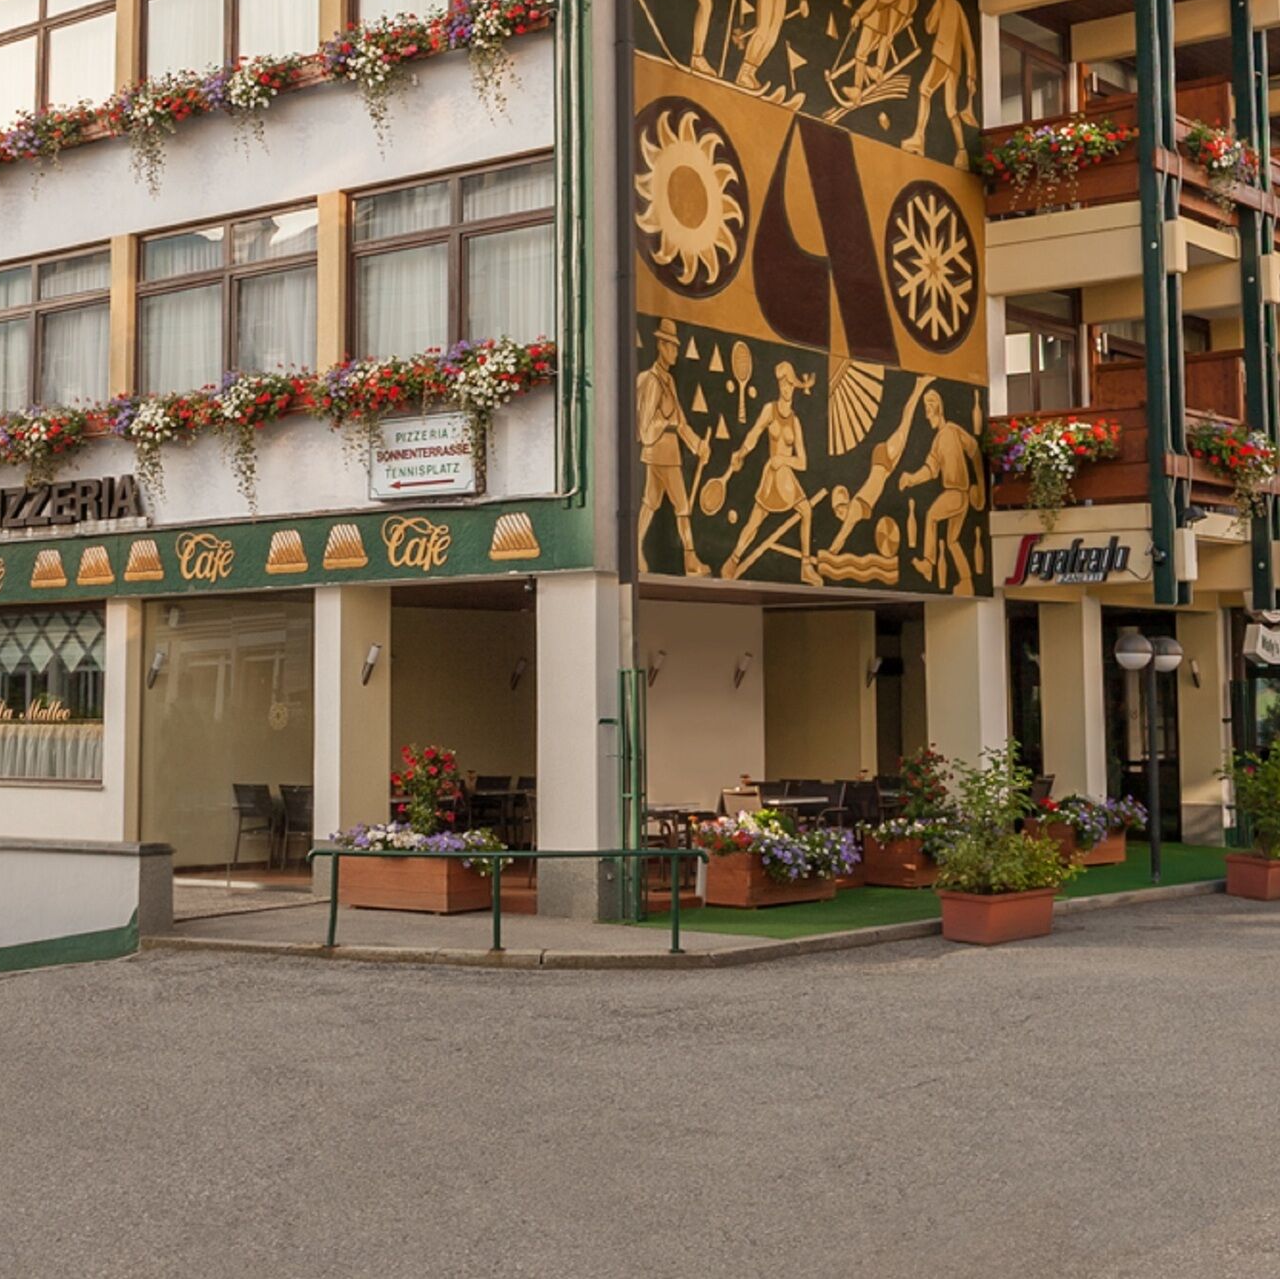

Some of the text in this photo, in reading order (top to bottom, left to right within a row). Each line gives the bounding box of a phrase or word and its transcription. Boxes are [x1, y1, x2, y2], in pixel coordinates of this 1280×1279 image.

[395, 428, 449, 443] PIZZERIA
[376, 443, 471, 463] SONNENTERRASSE
[385, 462, 460, 479] TENNISPLATZ
[1004, 533, 1130, 586] Segafredo
